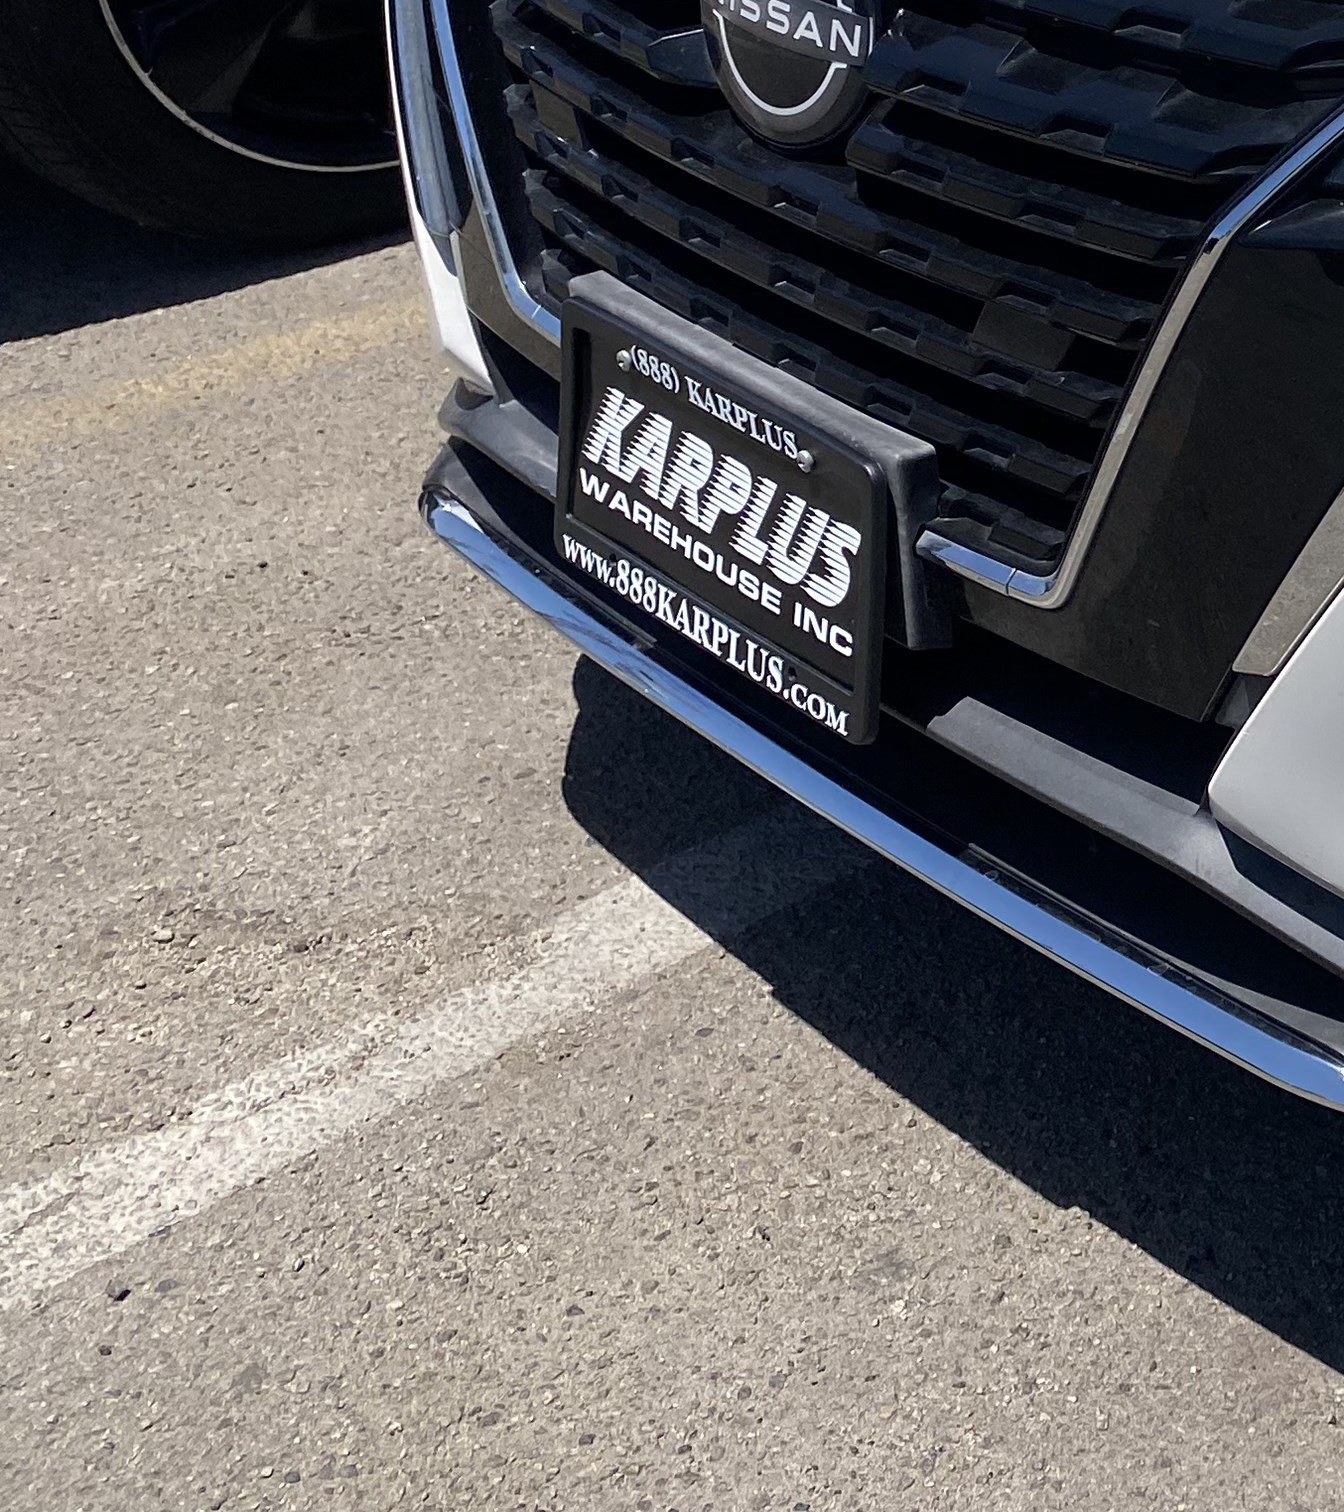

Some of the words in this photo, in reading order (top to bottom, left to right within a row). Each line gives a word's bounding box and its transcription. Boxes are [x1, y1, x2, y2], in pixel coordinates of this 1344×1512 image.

[581, 386, 862, 607] KARPLUS
[630, 344, 679, 394] (888)
[684, 375, 799, 458] KARPLUS
[580, 467, 783, 613] WAREHOUSE
[793, 600, 854, 658] INC
